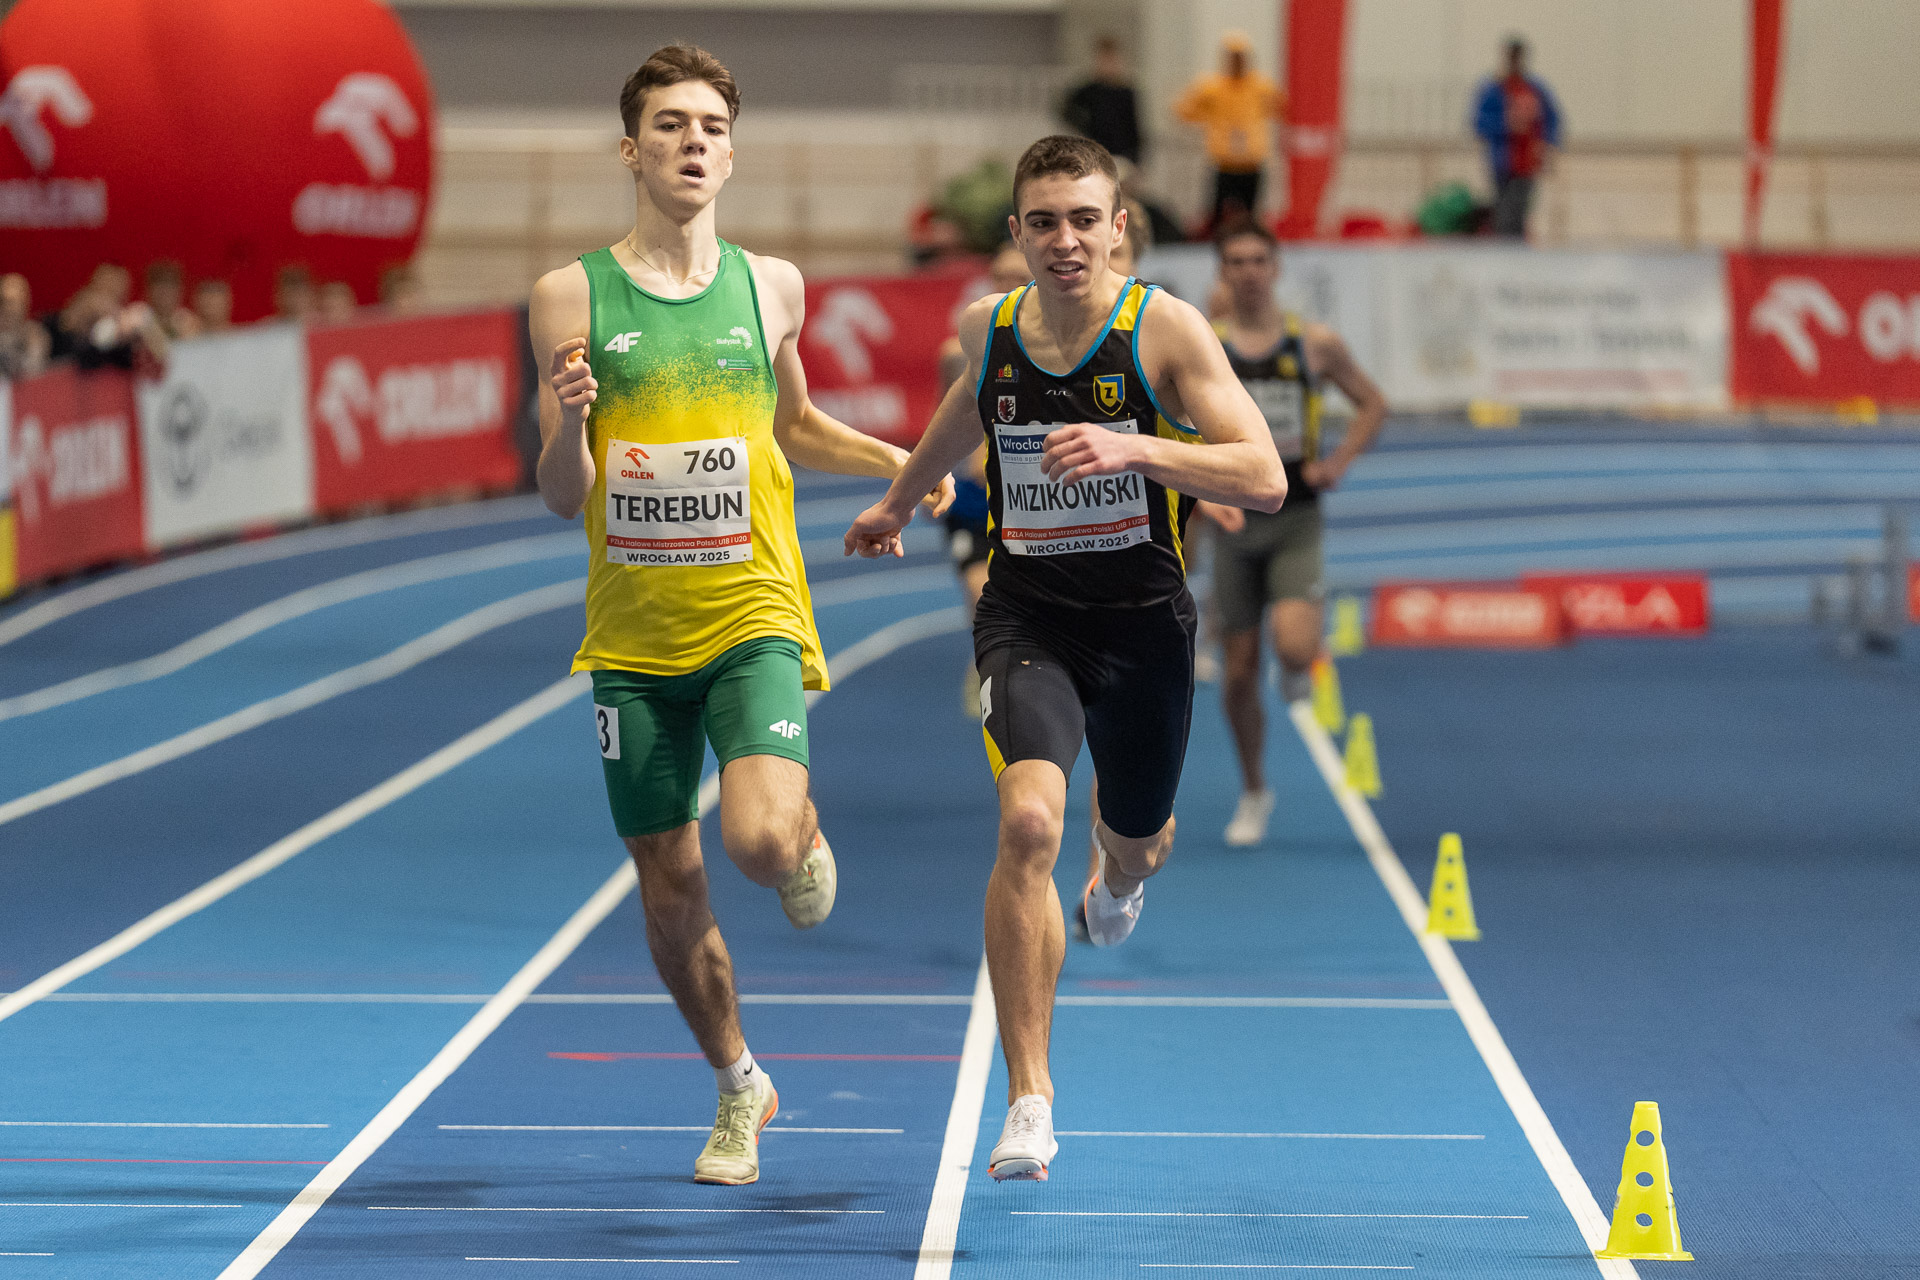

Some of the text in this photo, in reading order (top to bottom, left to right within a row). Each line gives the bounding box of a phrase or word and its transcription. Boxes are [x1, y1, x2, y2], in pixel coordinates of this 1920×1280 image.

[604, 331, 642, 353] 4F
[1104, 387, 1113, 399] Z
[683, 447, 736, 474] 760
[621, 470, 654, 480] ORLEN
[1007, 474, 1140, 512] MIZIKOWSKI
[611, 491, 743, 522] TEREBUN
[1049, 528, 1092, 537] Mistrzostwa
[1093, 525, 1115, 533] Polski
[1132, 518, 1147, 526] U20
[653, 540, 695, 548] Mistrzostwa
[696, 539, 717, 547] Polski
[718, 538, 730, 546] U18
[735, 535, 747, 543] U20
[1026, 534, 1130, 555] WROCŁAW 2025
[627, 551, 730, 563] WROCŁAW 2025
[597, 709, 611, 754] 3
[769, 719, 802, 739] 4F
